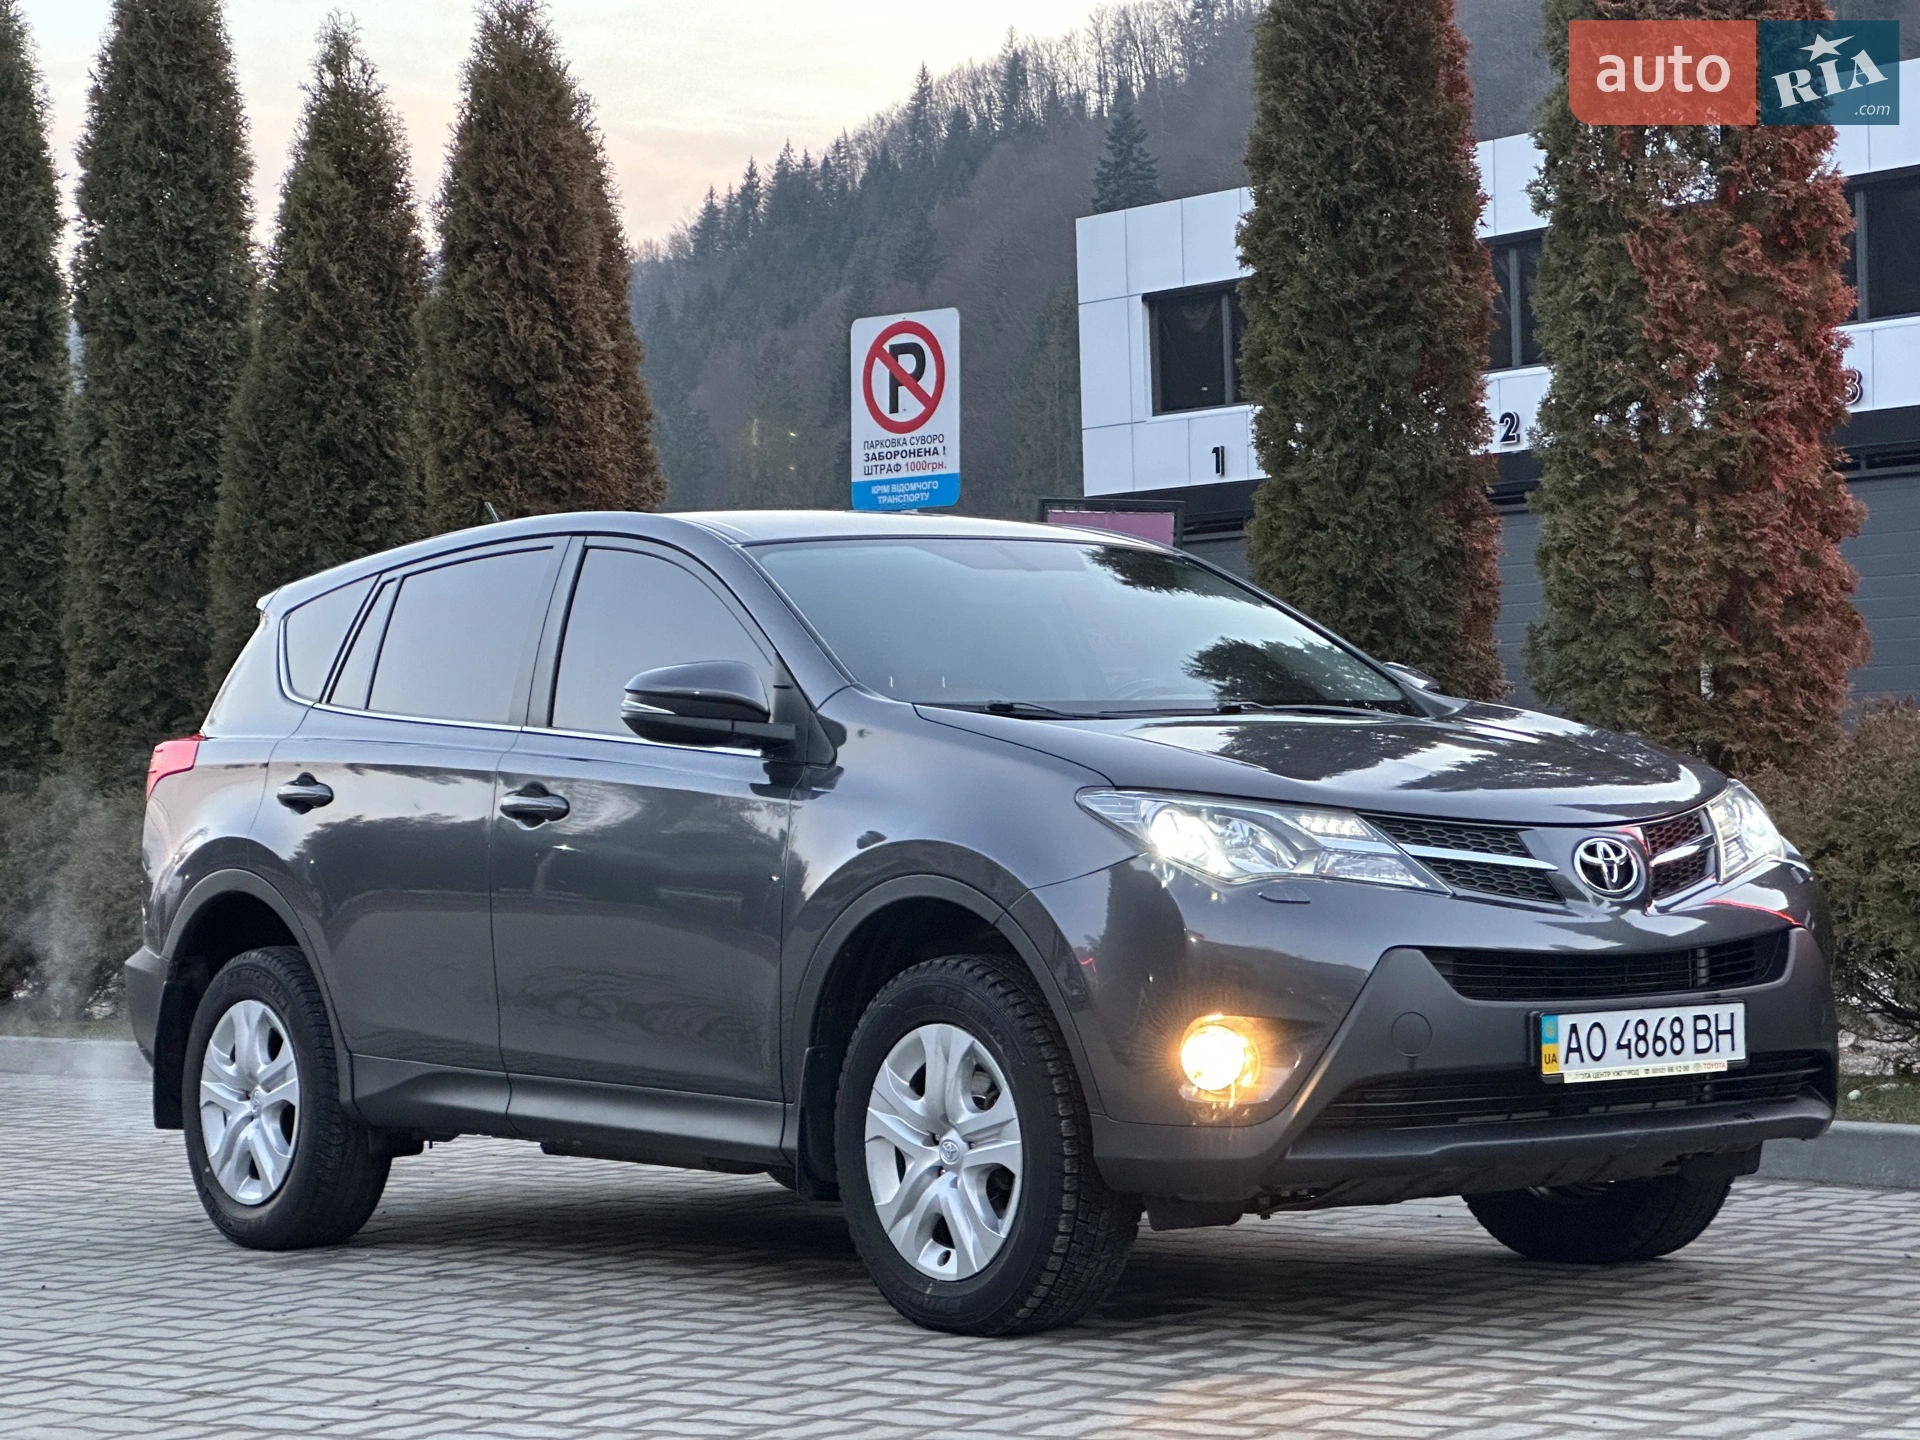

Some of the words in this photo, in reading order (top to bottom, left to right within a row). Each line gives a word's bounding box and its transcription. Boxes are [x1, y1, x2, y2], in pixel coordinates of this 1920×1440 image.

[1499, 411, 1521, 443] 2
[863, 436, 908, 451] ПАРКОВКА
[909, 433, 945, 446] СУВОРО
[863, 446, 940, 463] ЗАБОРОНЕНА
[1211, 445, 1225, 477] 1
[863, 462, 902, 476] ШТРАФ
[905, 460, 948, 473] 1000грн.
[891, 480, 939, 494] ВІДОМЧОГО
[877, 491, 930, 505] ТРАНСПОРТУ
[1564, 1021, 1607, 1065] AO
[1616, 1016, 1685, 1060] 4868
[1692, 1012, 1736, 1055] BH
[1544, 1053, 1558, 1065] UA
[1702, 1062, 1726, 1070] TOYOTA
